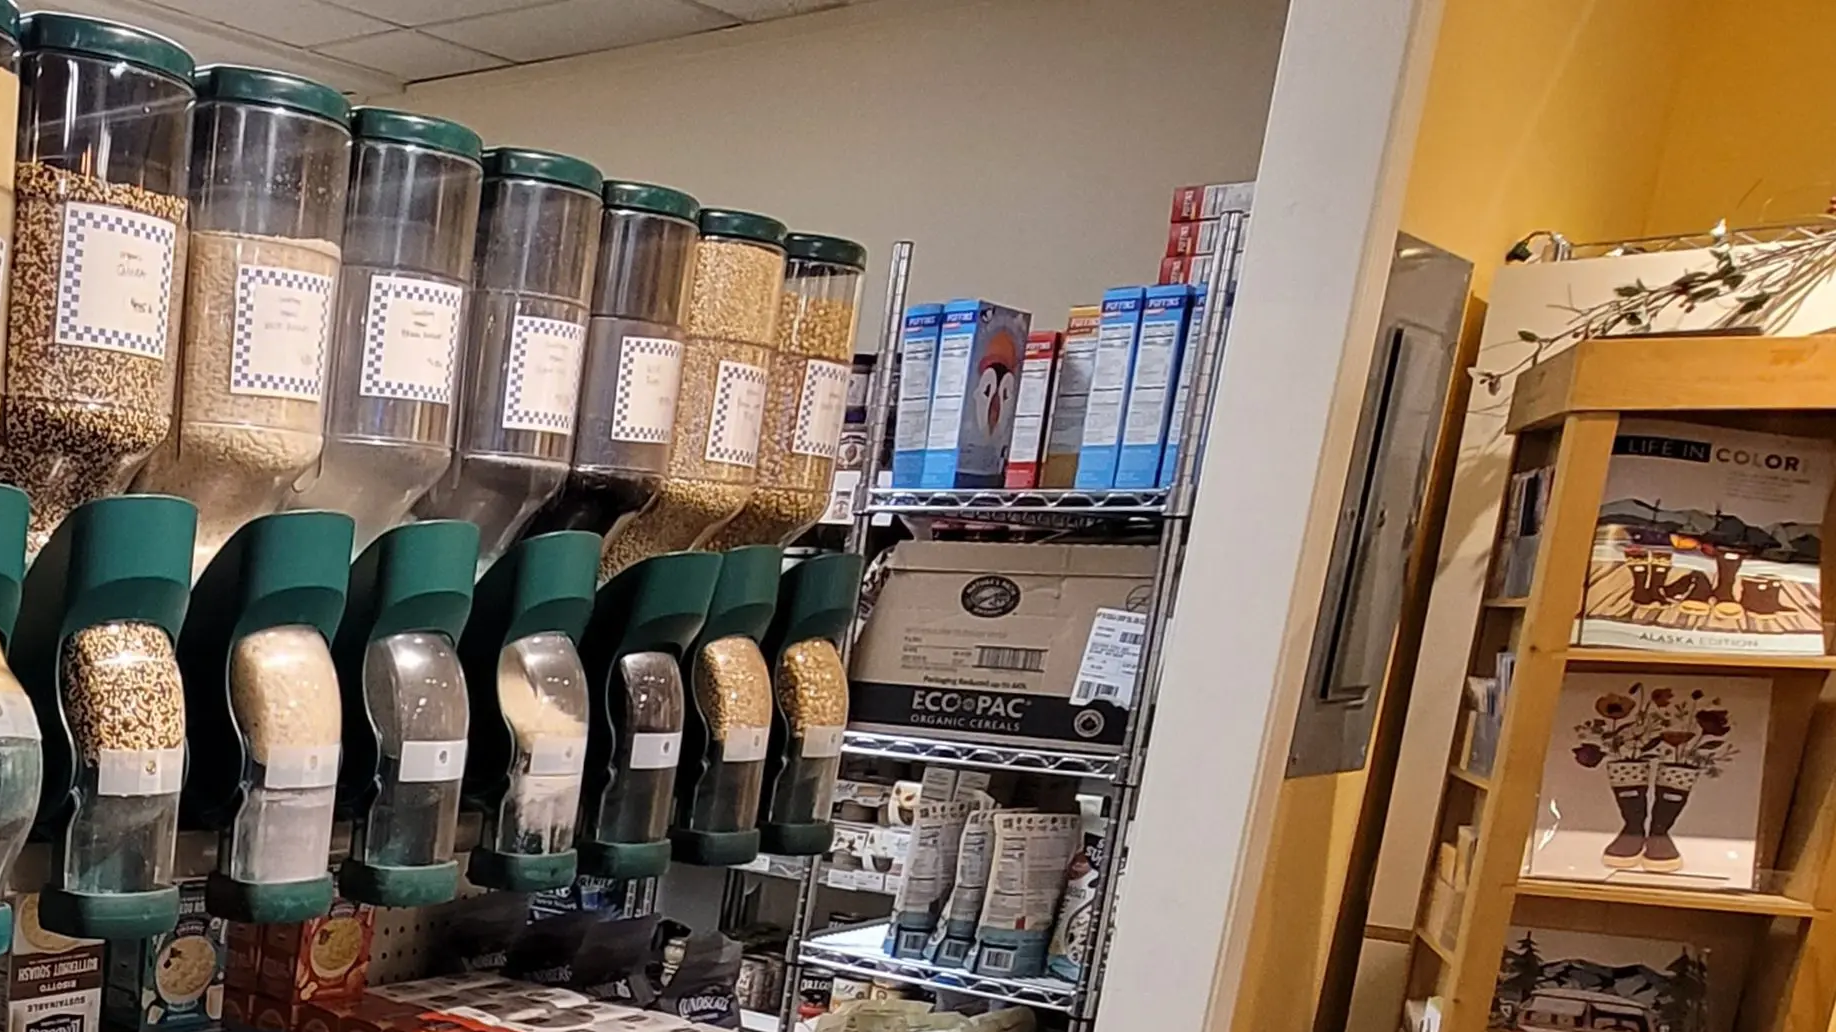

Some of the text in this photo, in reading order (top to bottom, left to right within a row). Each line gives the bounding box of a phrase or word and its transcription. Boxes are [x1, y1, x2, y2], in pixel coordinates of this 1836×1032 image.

[1629, 439, 1673, 457] LIFE
[1684, 443, 1705, 459] IN
[1639, 632, 1694, 645] ALASKA
[912, 690, 1024, 719] ECO PAC
[910, 714, 1021, 733] ORGANIC CEREALS
[27, 995, 86, 1012] SUSTAINABLE
